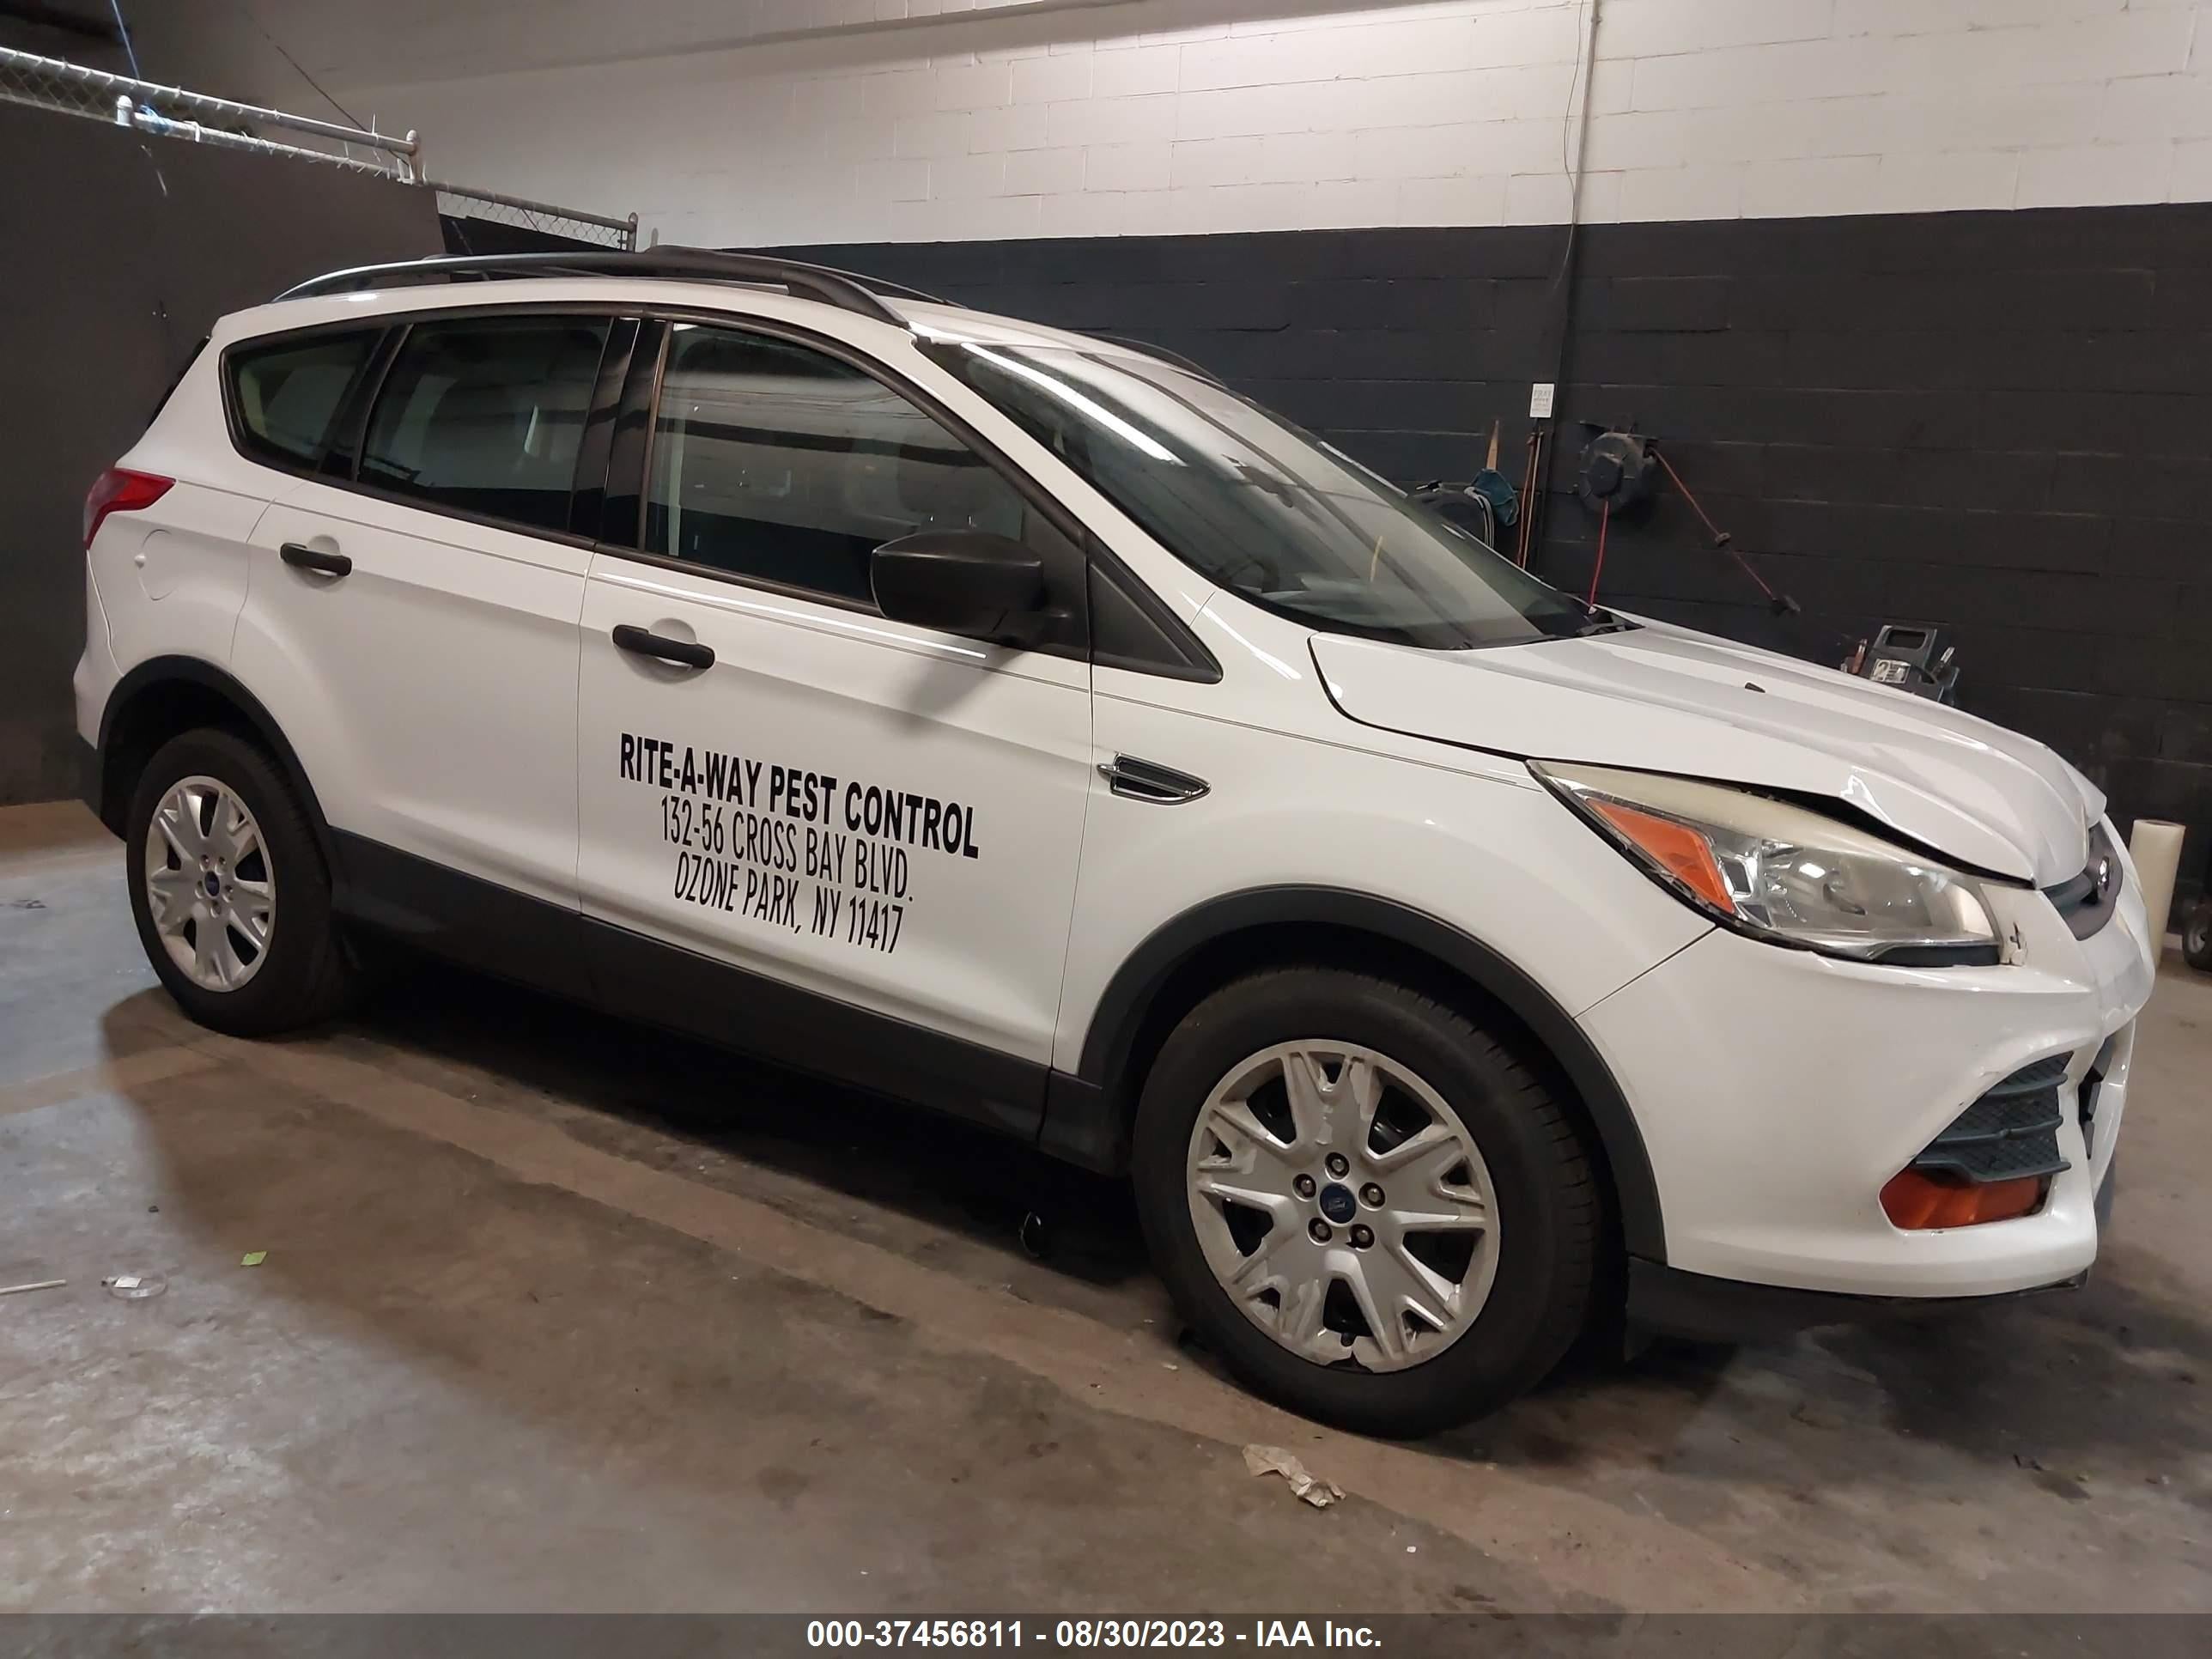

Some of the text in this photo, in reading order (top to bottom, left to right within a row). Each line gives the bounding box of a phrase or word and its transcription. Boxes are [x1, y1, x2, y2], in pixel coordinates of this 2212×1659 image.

[620, 732, 979, 859] RITE-A-WAY PEST CONTROL
[661, 795, 914, 902] 132-56 CROSS BAY BLVD.
[674, 851, 902, 954] OZONE PARK, NY 11417
